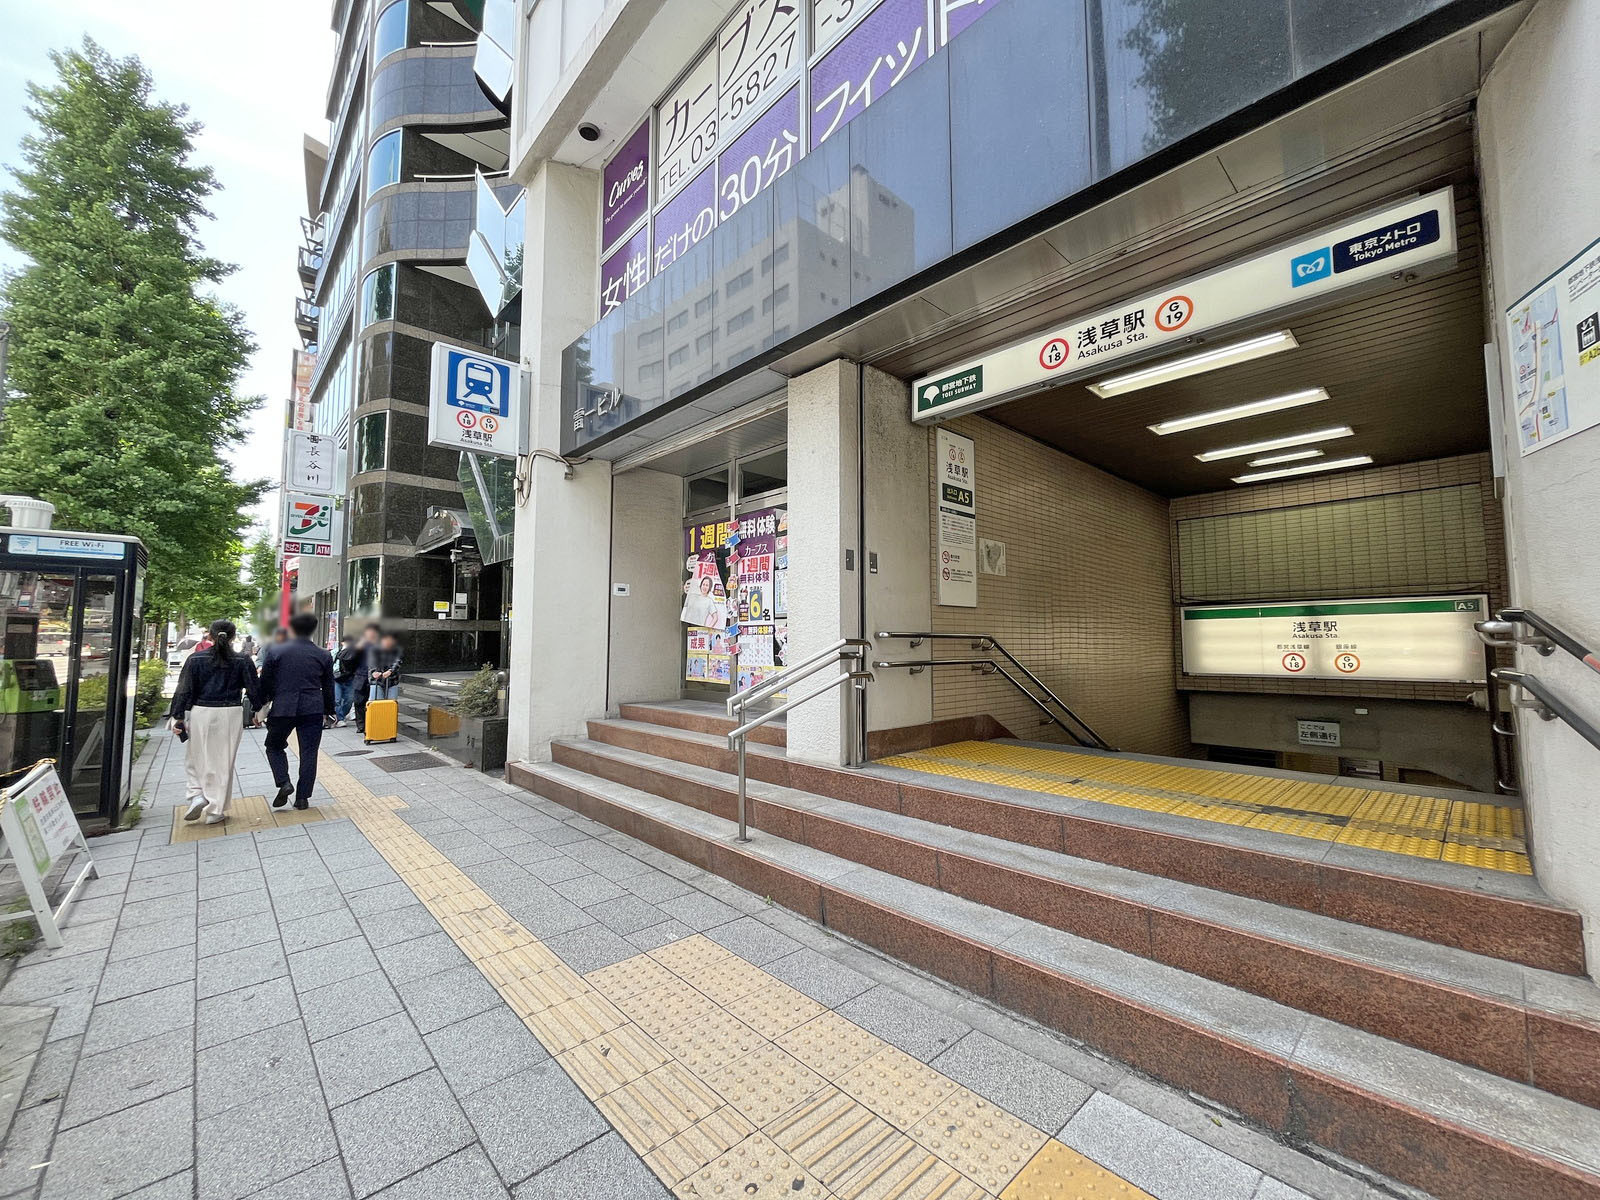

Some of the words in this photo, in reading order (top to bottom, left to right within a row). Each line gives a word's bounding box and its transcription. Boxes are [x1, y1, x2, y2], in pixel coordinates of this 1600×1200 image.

[608, 160, 644, 208] Curves
[1348, 222, 1421, 256] 東京メトロ
[1353, 247, 1383, 262] Tokyo
[1385, 236, 1417, 252] Metro
[1169, 302, 1180, 312] G
[1166, 311, 1184, 325] 19
[1077, 308, 1145, 349] 浅草駅
[1051, 344, 1058, 353] A
[1077, 342, 1123, 361] Asakusa
[1126, 331, 1149, 345] Sta.
[1048, 352, 1061, 364] 18
[942, 391, 953, 399] TOEI
[955, 383, 976, 395] SUBWAY
[462, 428, 493, 442] 浅草駅
[306, 446, 322, 485] 長谷川
[946, 462, 969, 479] 浅草駅
[958, 490, 970, 504] A5
[739, 514, 775, 540] 無料体験
[303, 545, 313, 554] 酒
[316, 546, 331, 555] ATM
[741, 555, 770, 574] 1週間
[740, 572, 770, 584] 無料体験
[750, 593, 761, 618] 6
[762, 608, 771, 621] 名
[1458, 602, 1474, 610] A5
[1293, 621, 1338, 632] 浅草駅
[690, 638, 705, 650] 成果
[1300, 731, 1337, 741] 左側通行
